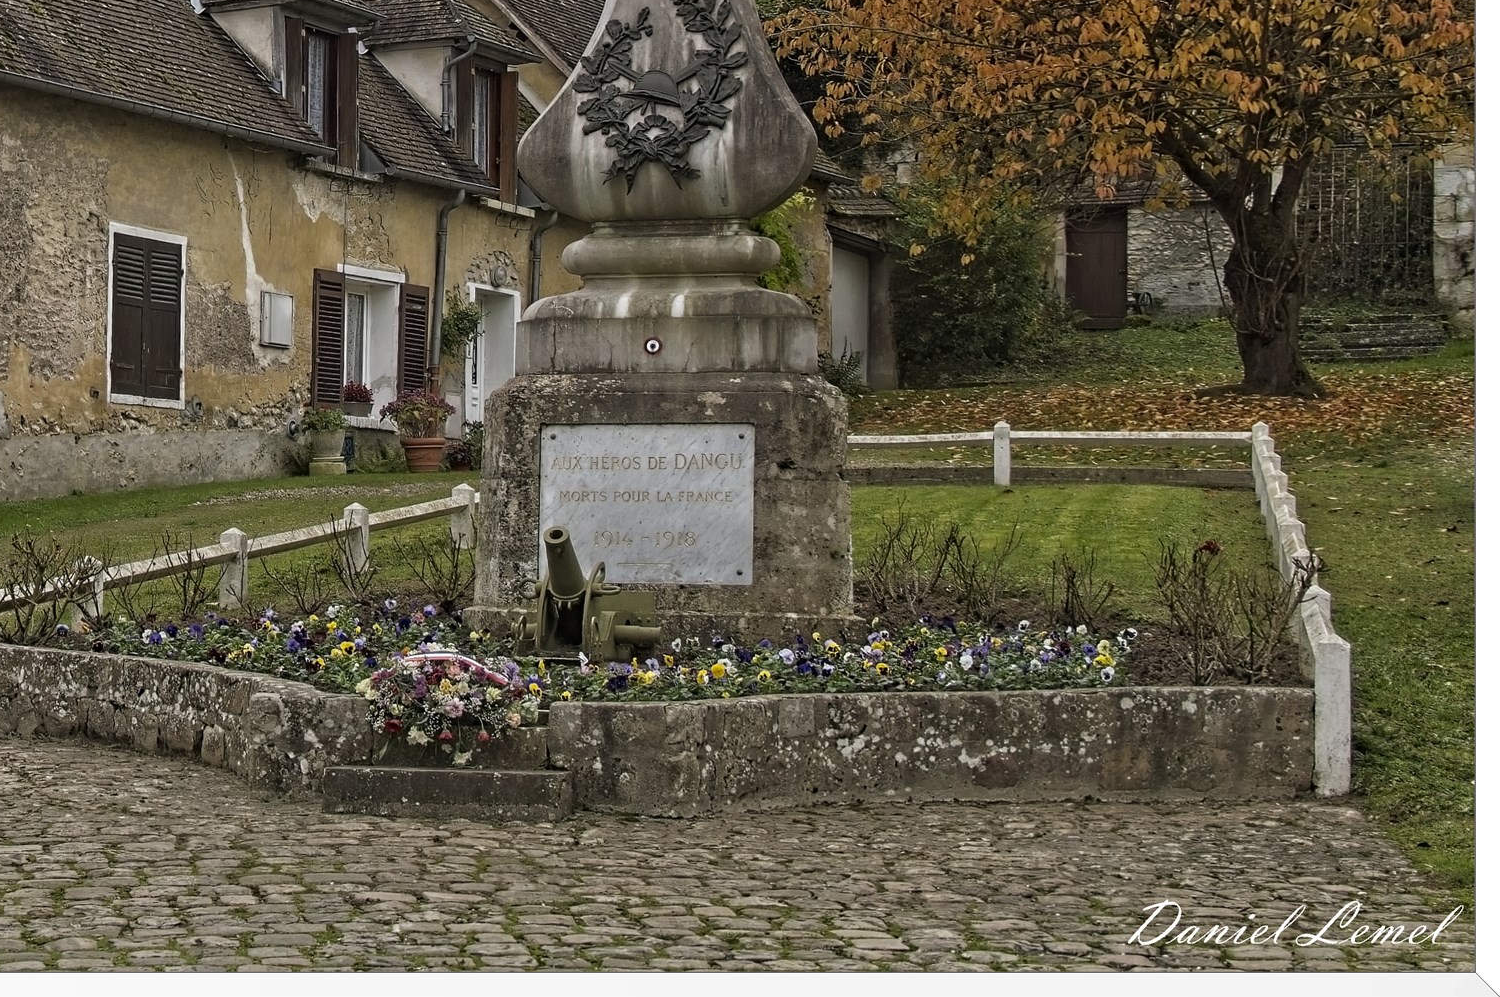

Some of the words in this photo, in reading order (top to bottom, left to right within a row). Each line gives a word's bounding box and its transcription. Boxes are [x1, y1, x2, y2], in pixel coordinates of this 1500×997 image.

[550, 456, 583, 471] AUX
[647, 456, 668, 471] DE
[674, 453, 743, 470] DANGU
[558, 490, 608, 503] MORTS
[612, 490, 651, 503] POUR
[656, 490, 674, 503] LA
[677, 490, 734, 503] FRANCE
[593, 530, 634, 549] 1914
[655, 530, 697, 550] 1918
